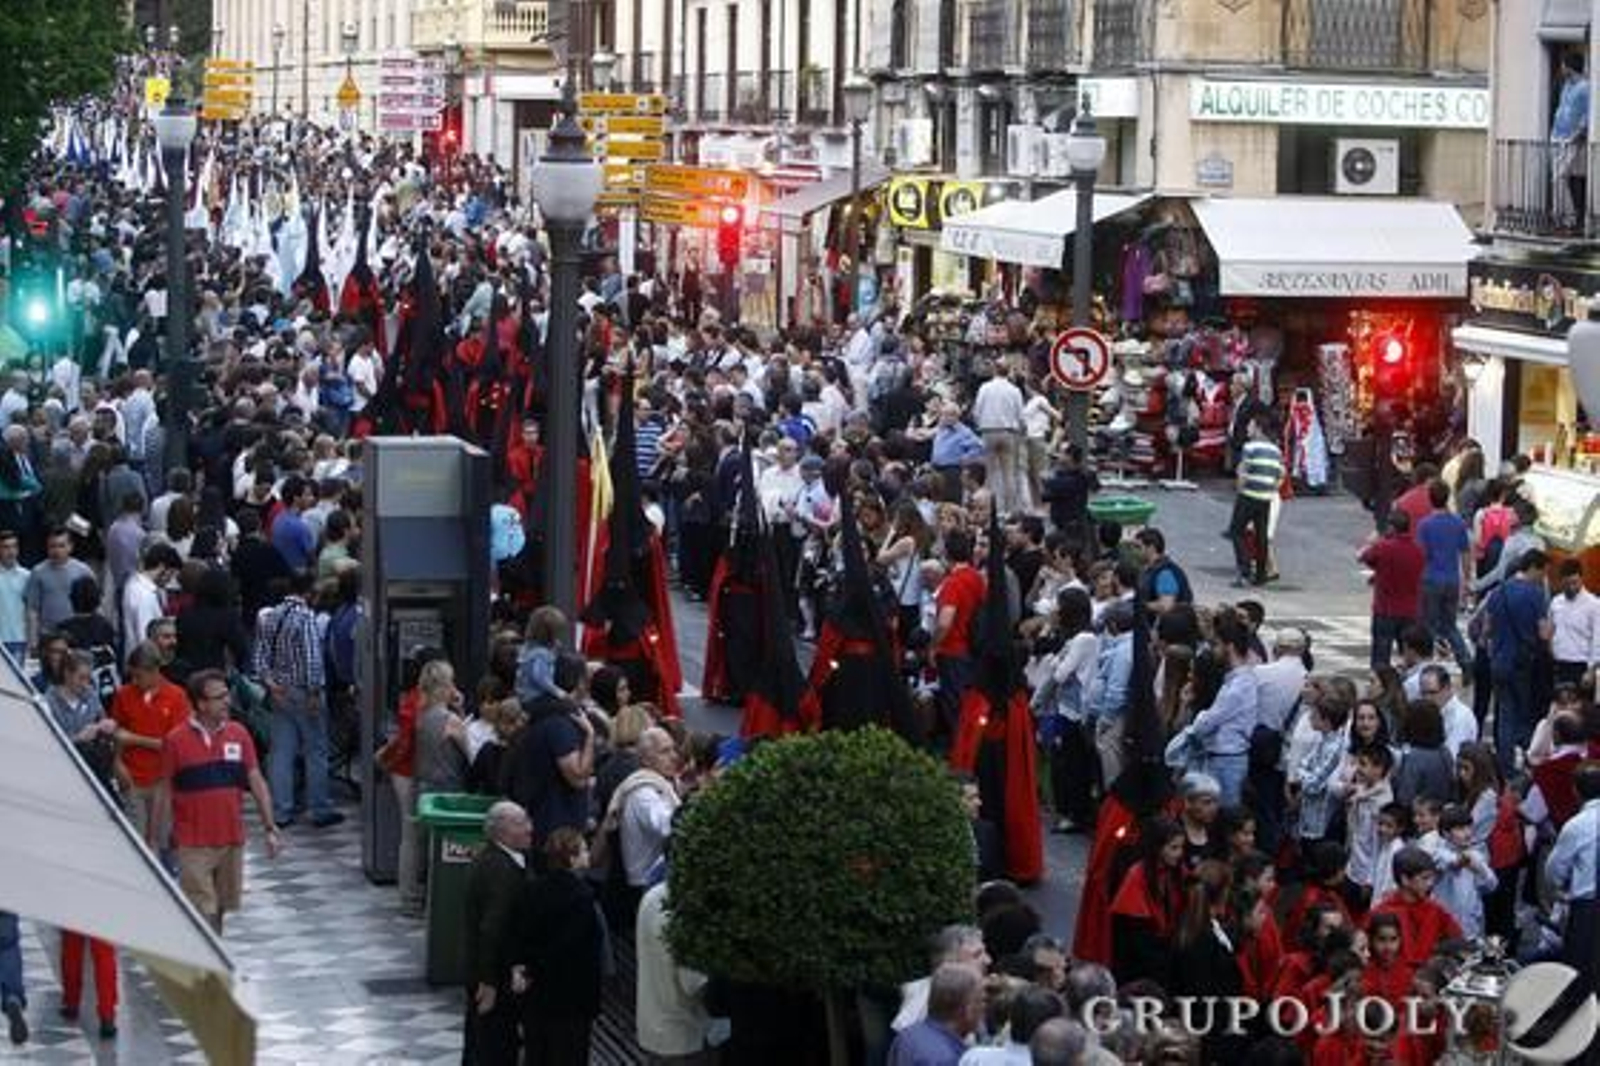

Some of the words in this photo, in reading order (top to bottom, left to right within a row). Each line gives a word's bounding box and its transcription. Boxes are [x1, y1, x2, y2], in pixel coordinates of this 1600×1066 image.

[1199, 84, 1310, 117] ALQUILER
[1315, 88, 1346, 119] DE
[1353, 90, 1447, 122] COCHES
